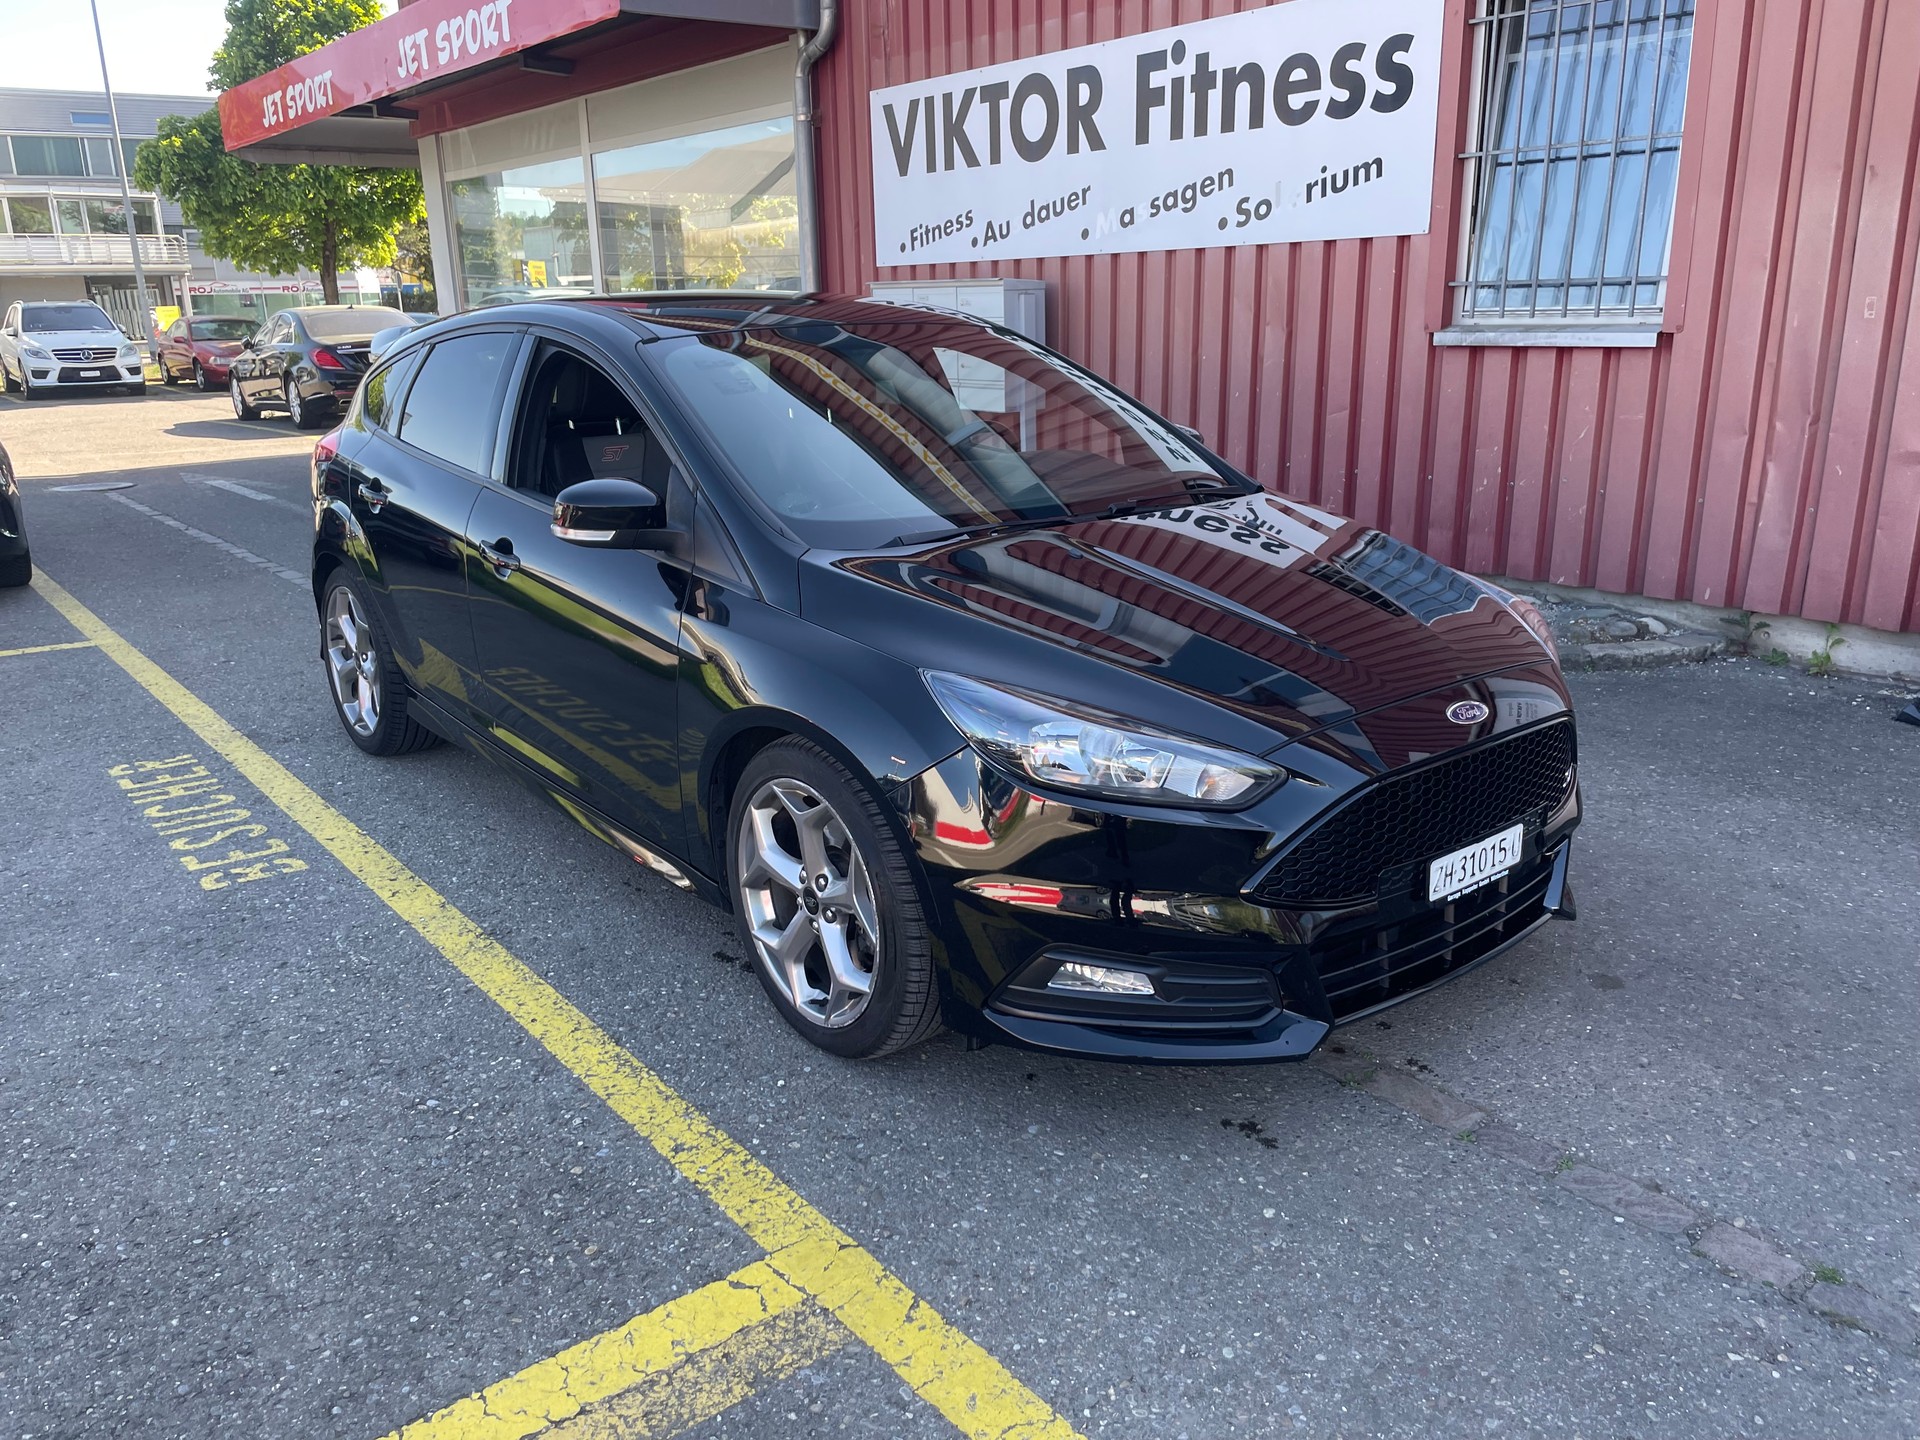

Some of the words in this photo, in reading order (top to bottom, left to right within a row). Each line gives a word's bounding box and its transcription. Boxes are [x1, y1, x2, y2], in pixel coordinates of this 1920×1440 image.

[397, 28, 430, 79] JET
[435, 0, 513, 66] SPORT
[262, 90, 284, 128] JET
[286, 69, 334, 120] SPORT
[882, 64, 1107, 178] VIKTOR
[1134, 32, 1416, 146] Fitness
[909, 209, 974, 252] Fitness
[602, 444, 629, 462] ST
[1456, 705, 1481, 720] Ford
